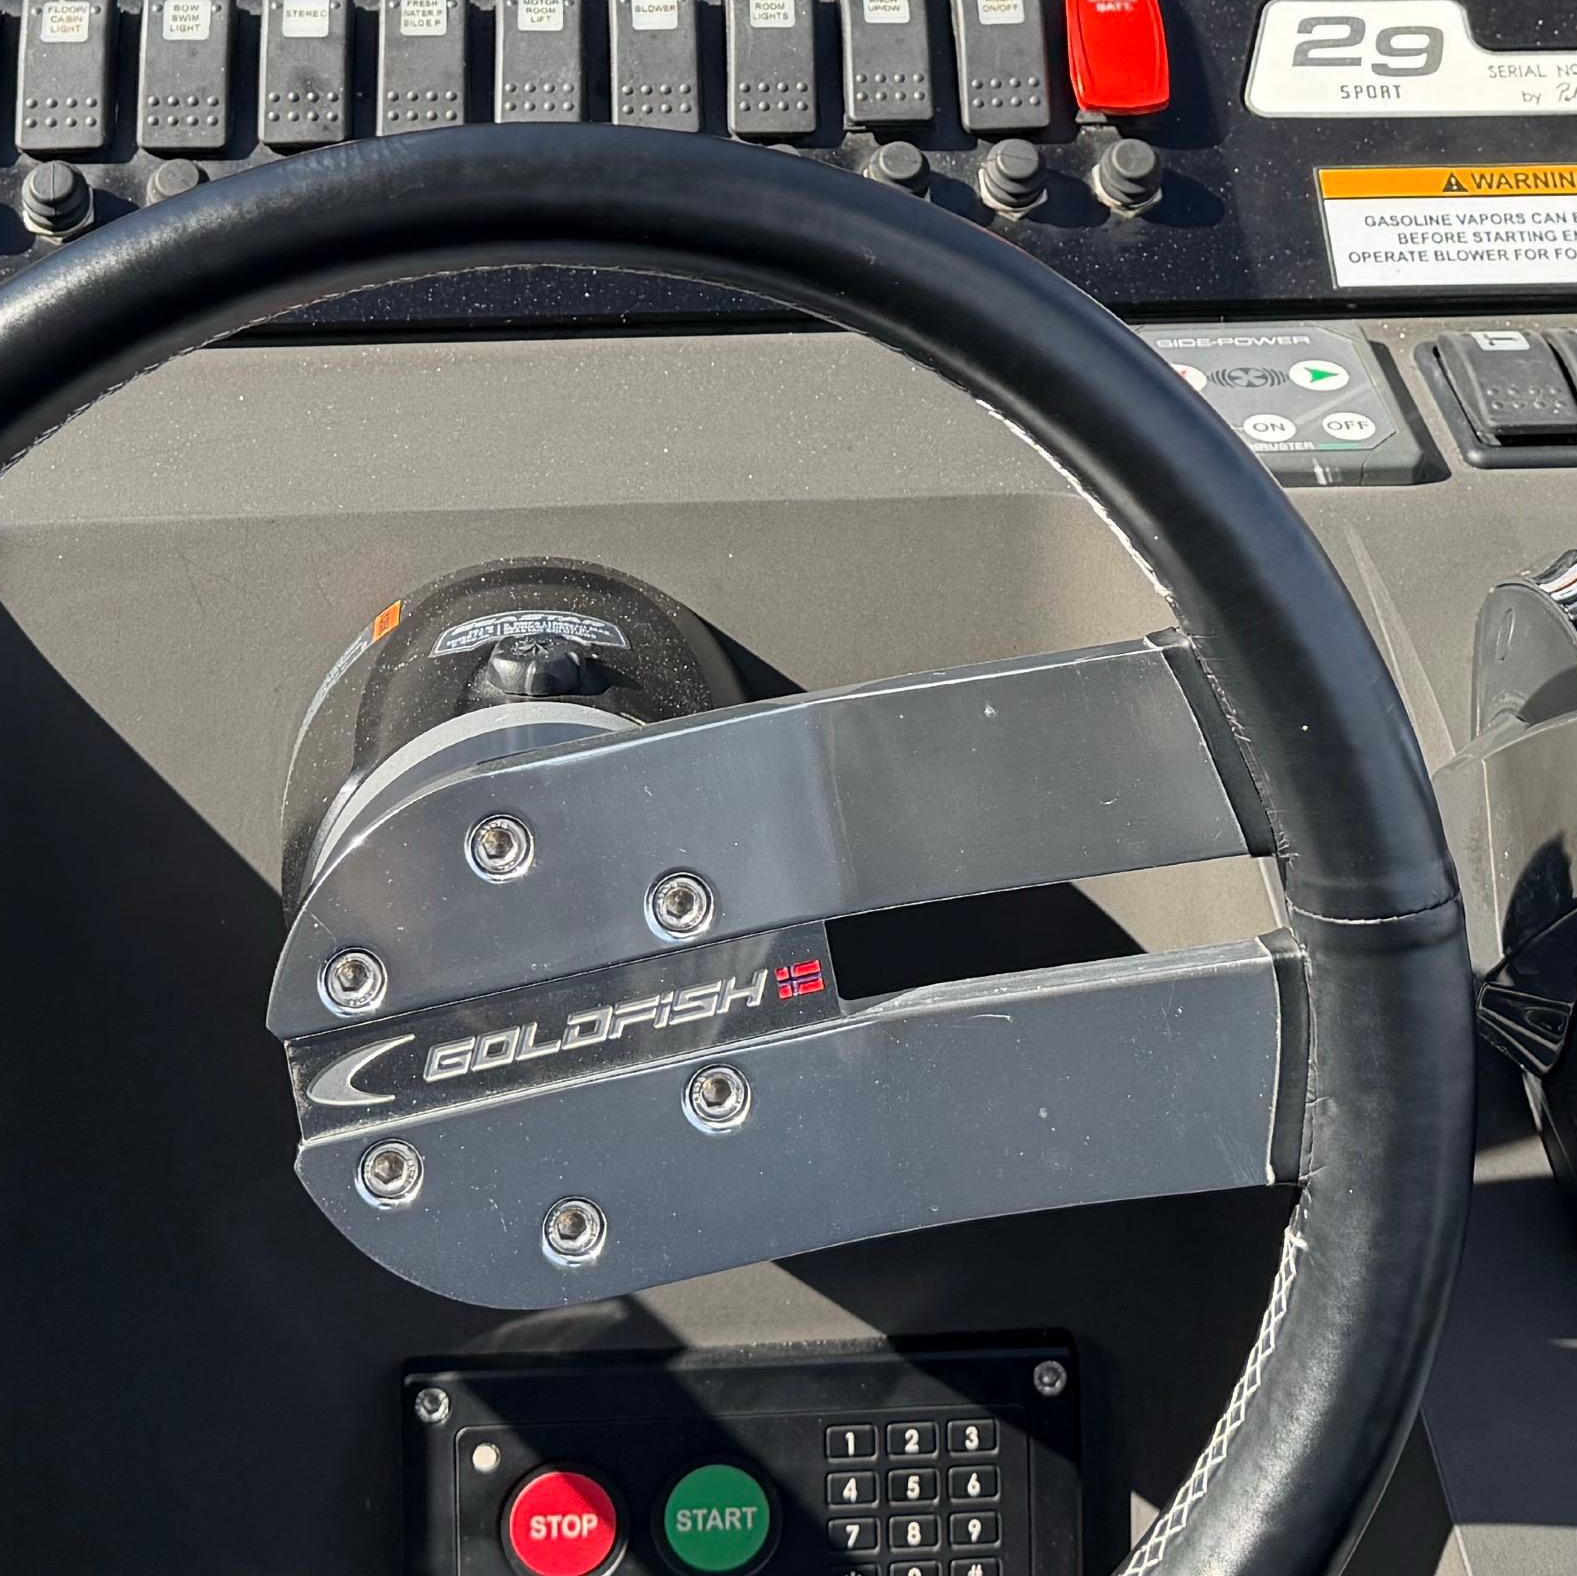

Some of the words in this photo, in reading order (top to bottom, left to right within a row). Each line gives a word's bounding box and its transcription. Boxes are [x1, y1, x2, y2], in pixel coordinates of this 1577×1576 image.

[174, 4, 199, 12] BOW
[406, 0, 438, 7] FRESH
[635, 5, 676, 13] BLOWER
[755, 2, 785, 10] ROOM
[50, 15, 83, 23] CABIN
[171, 14, 199, 22] SWIM
[286, 10, 328, 18] STEREO
[753, 12, 788, 21] LIGHTS
[50, 25, 81, 33] LIGHT
[170, 24, 199, 32] LIGHT
[1291, 15, 1445, 78] 29
[1488, 64, 1547, 78] SERIAL
[1340, 84, 1403, 100] SPORT
[1522, 90, 1542, 105] by
[1364, 214, 1452, 228] GASOLINE
[1457, 213, 1525, 226] VAPORS
[1532, 212, 1567, 225] CAN
[1397, 231, 1468, 245] BEFORE
[1473, 230, 1558, 244] STARTING
[1348, 250, 1429, 264] OPERATE
[1435, 249, 1510, 262] BLOWER
[1514, 248, 1551, 262] FOR
[1155, 335, 1311, 348] SIDE-POWER
[1252, 422, 1287, 433] ON
[1327, 420, 1369, 431] OFF
[845, 1431, 855, 1456] 1
[904, 1428, 919, 1454] 2
[965, 1426, 979, 1450] 3
[843, 1477, 857, 1503] 4
[906, 1475, 920, 1500] 5
[967, 1472, 981, 1497] 6
[676, 1506, 757, 1532] START
[529, 1513, 599, 1540] STOP
[846, 1524, 860, 1549] 7
[907, 1521, 921, 1547] 8
[968, 1518, 982, 1543] 9
